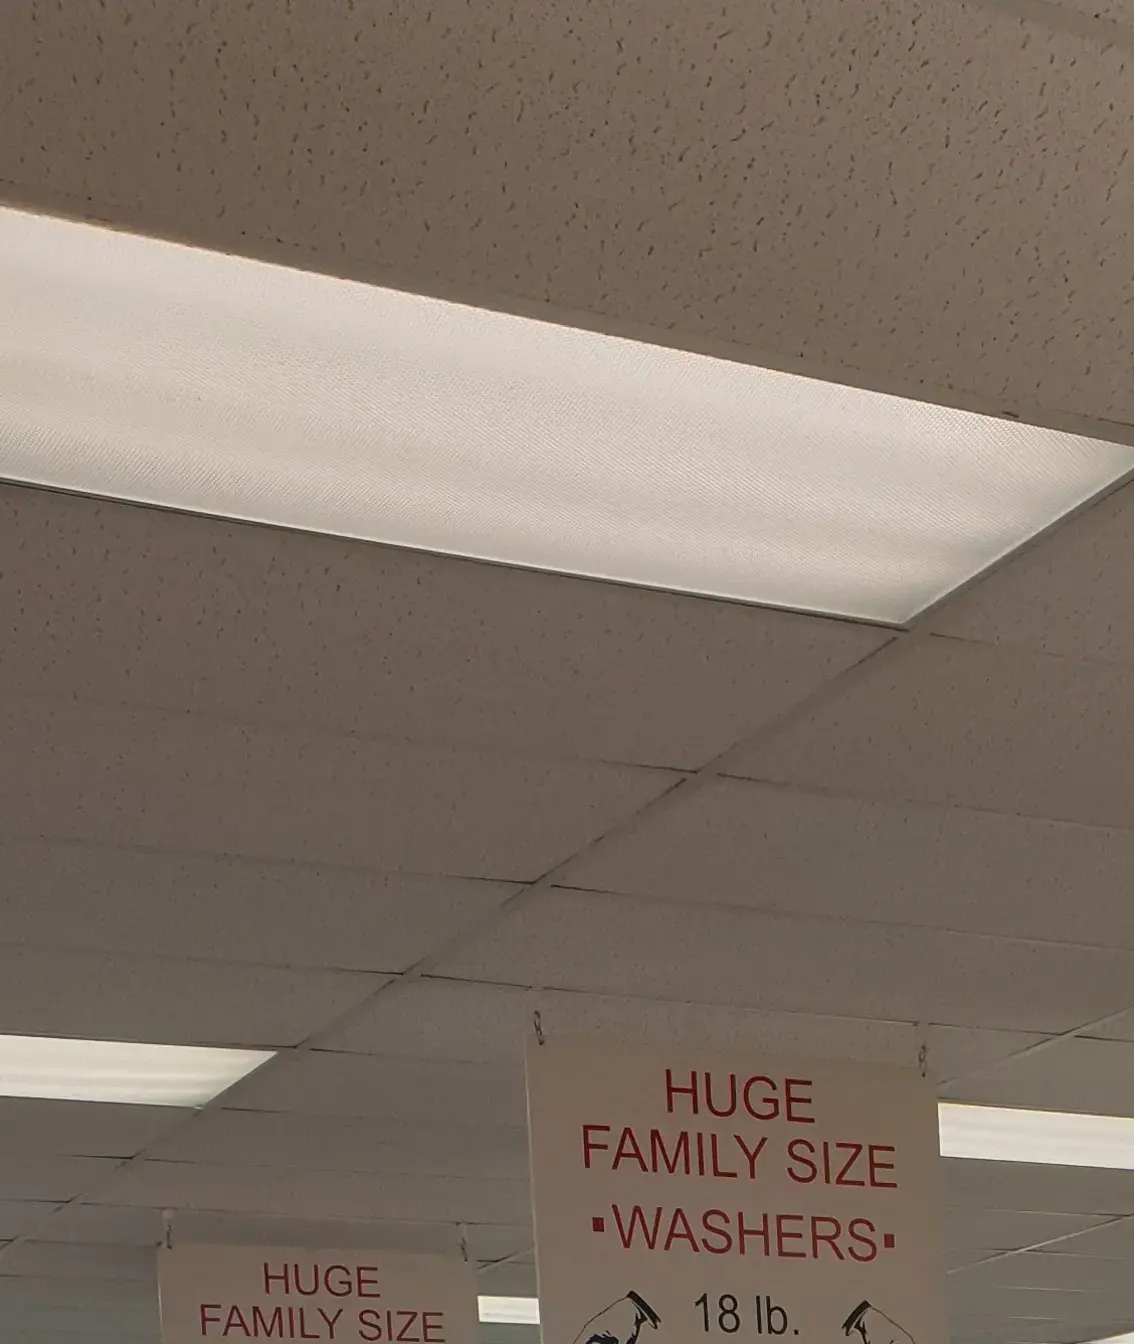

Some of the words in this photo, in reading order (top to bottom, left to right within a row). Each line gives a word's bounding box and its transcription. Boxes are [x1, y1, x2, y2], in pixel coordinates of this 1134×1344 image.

[666, 1069, 815, 1123] HUGE
[583, 1125, 767, 1179] FAMILY
[787, 1139, 897, 1188] SIZE
[264, 1263, 380, 1297] HUGE
[200, 1304, 343, 1339] FAMILY
[359, 1310, 445, 1342] SIZE
[695, 1293, 740, 1333] 18
[756, 1296, 798, 1335] lb.
